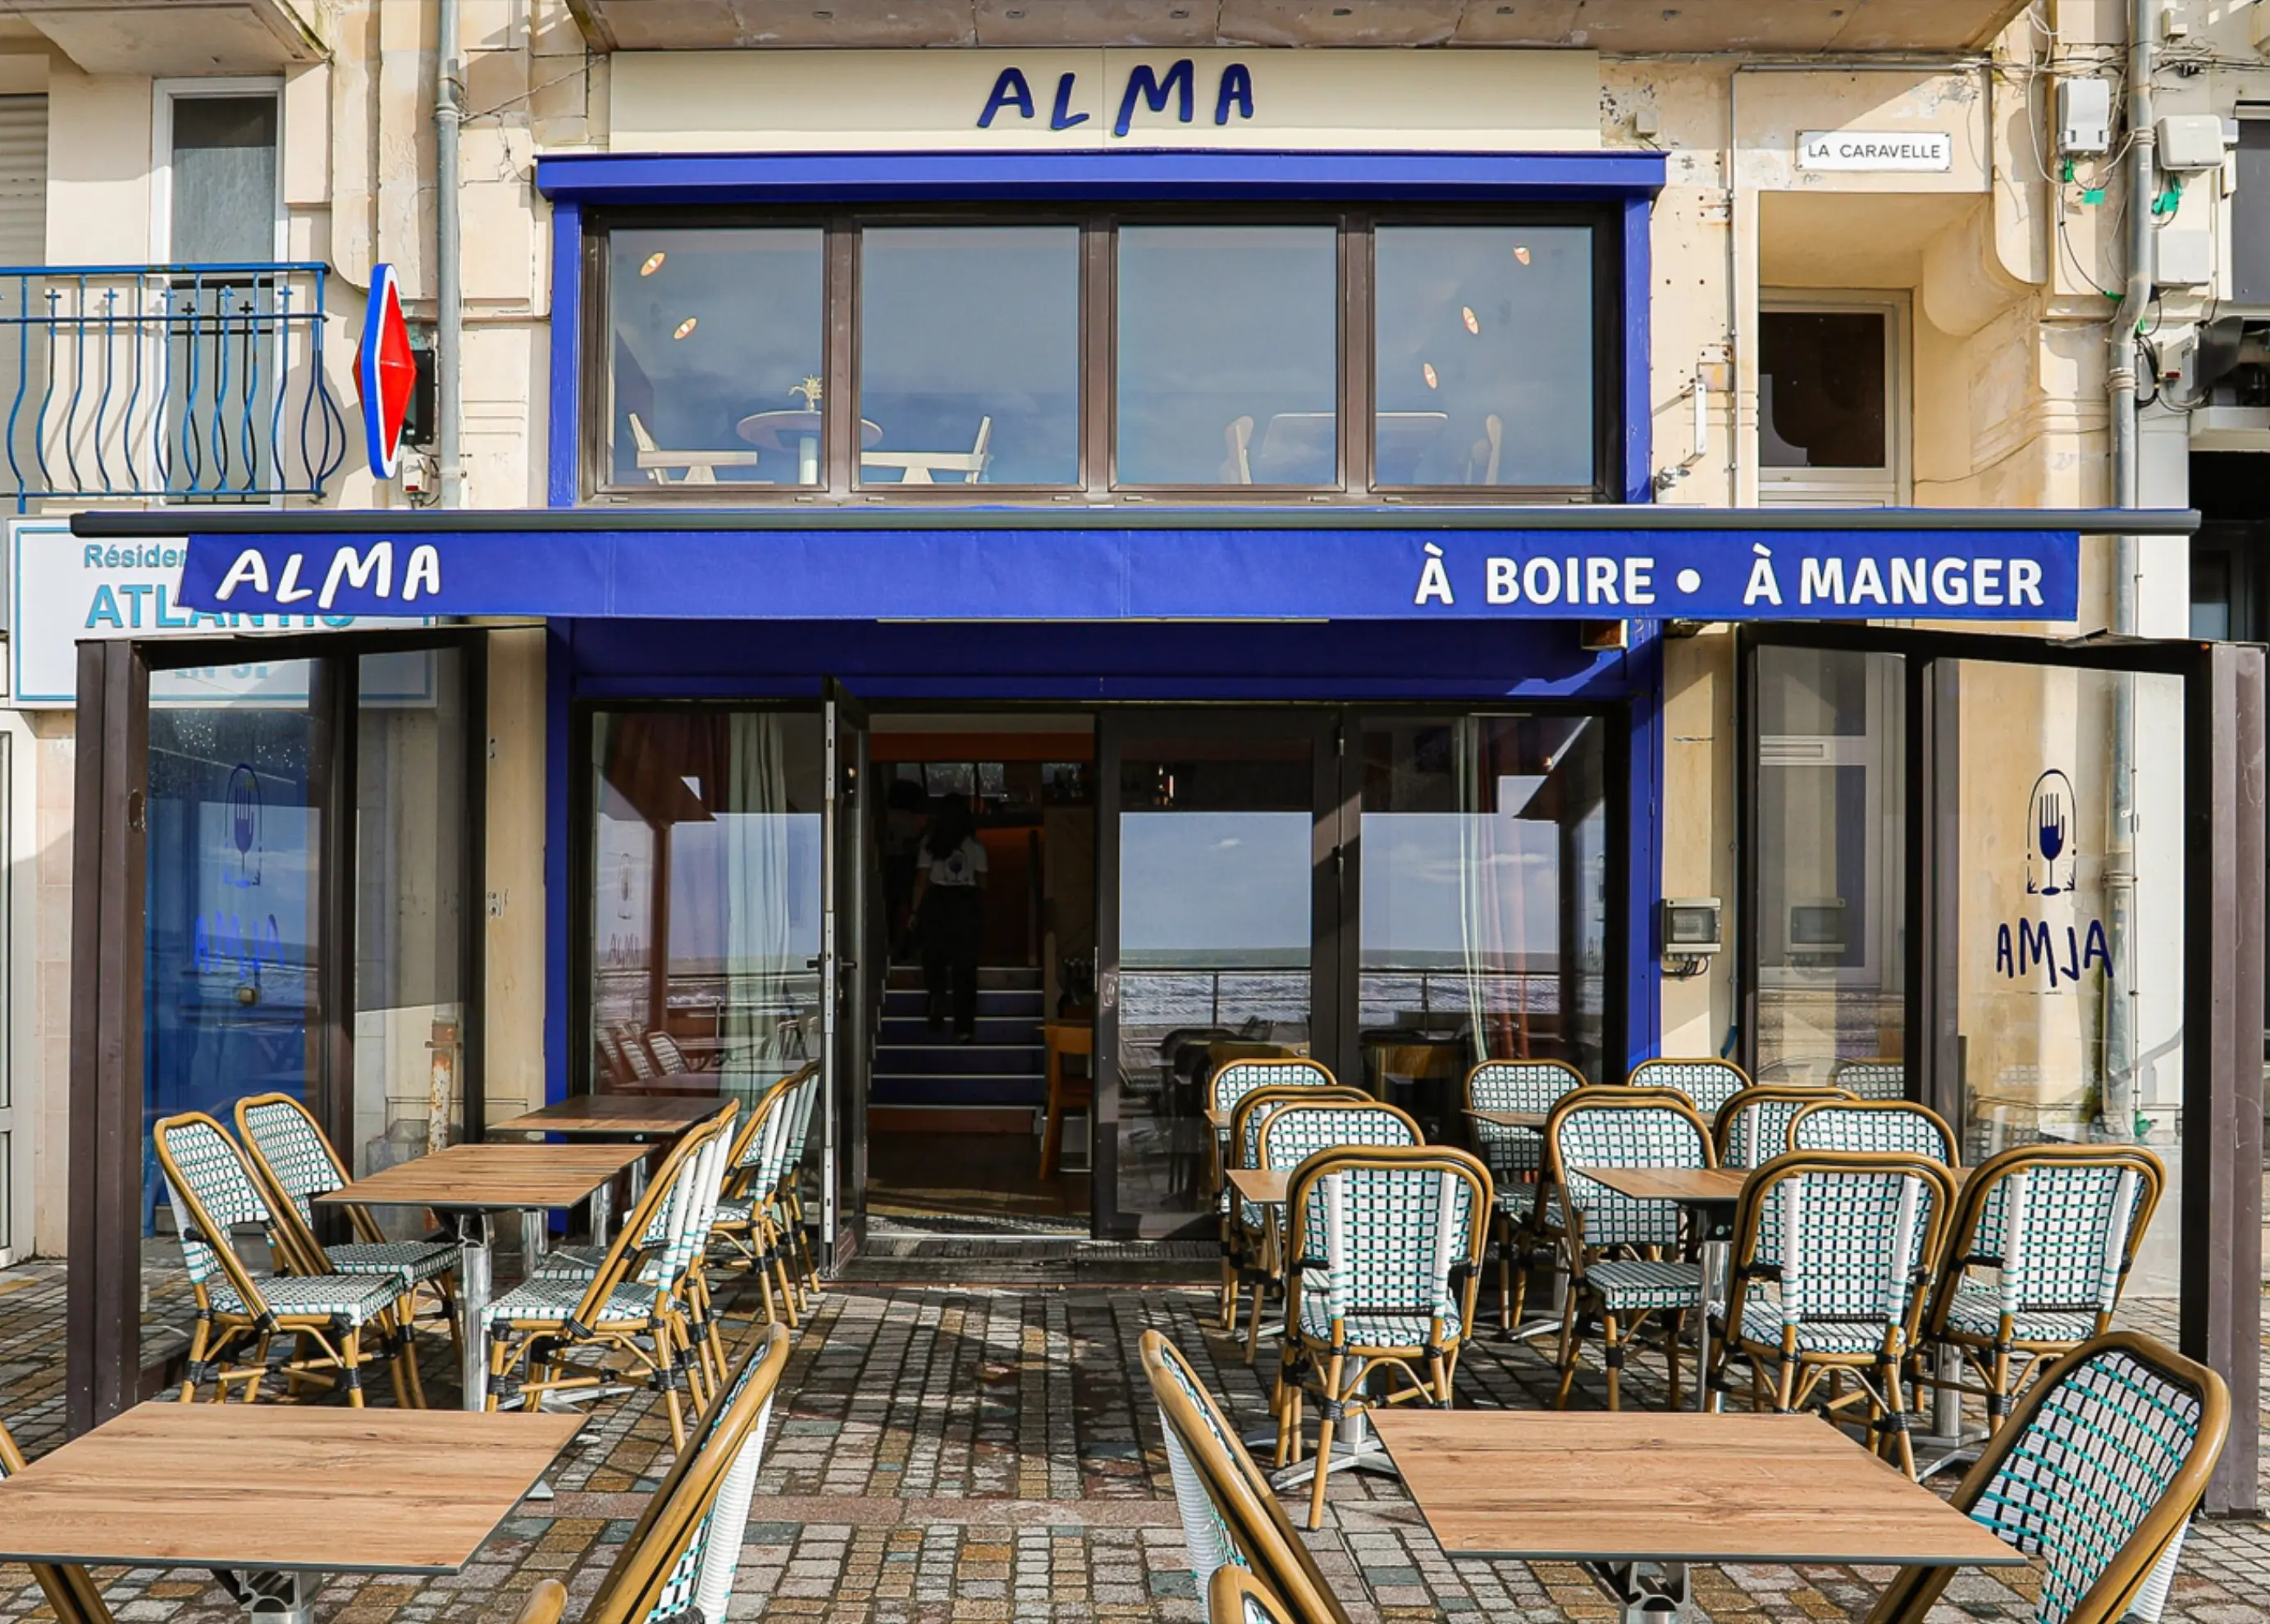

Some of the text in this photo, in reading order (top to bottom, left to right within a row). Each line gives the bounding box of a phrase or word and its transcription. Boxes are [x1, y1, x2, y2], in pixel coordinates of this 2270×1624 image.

[976, 58, 1254, 138] ALMA
[1807, 144, 1941, 159] LA CARAVELLE
[214, 540, 441, 610] ALMA
[1414, 541, 2044, 607] À BOIRE À MANGER
